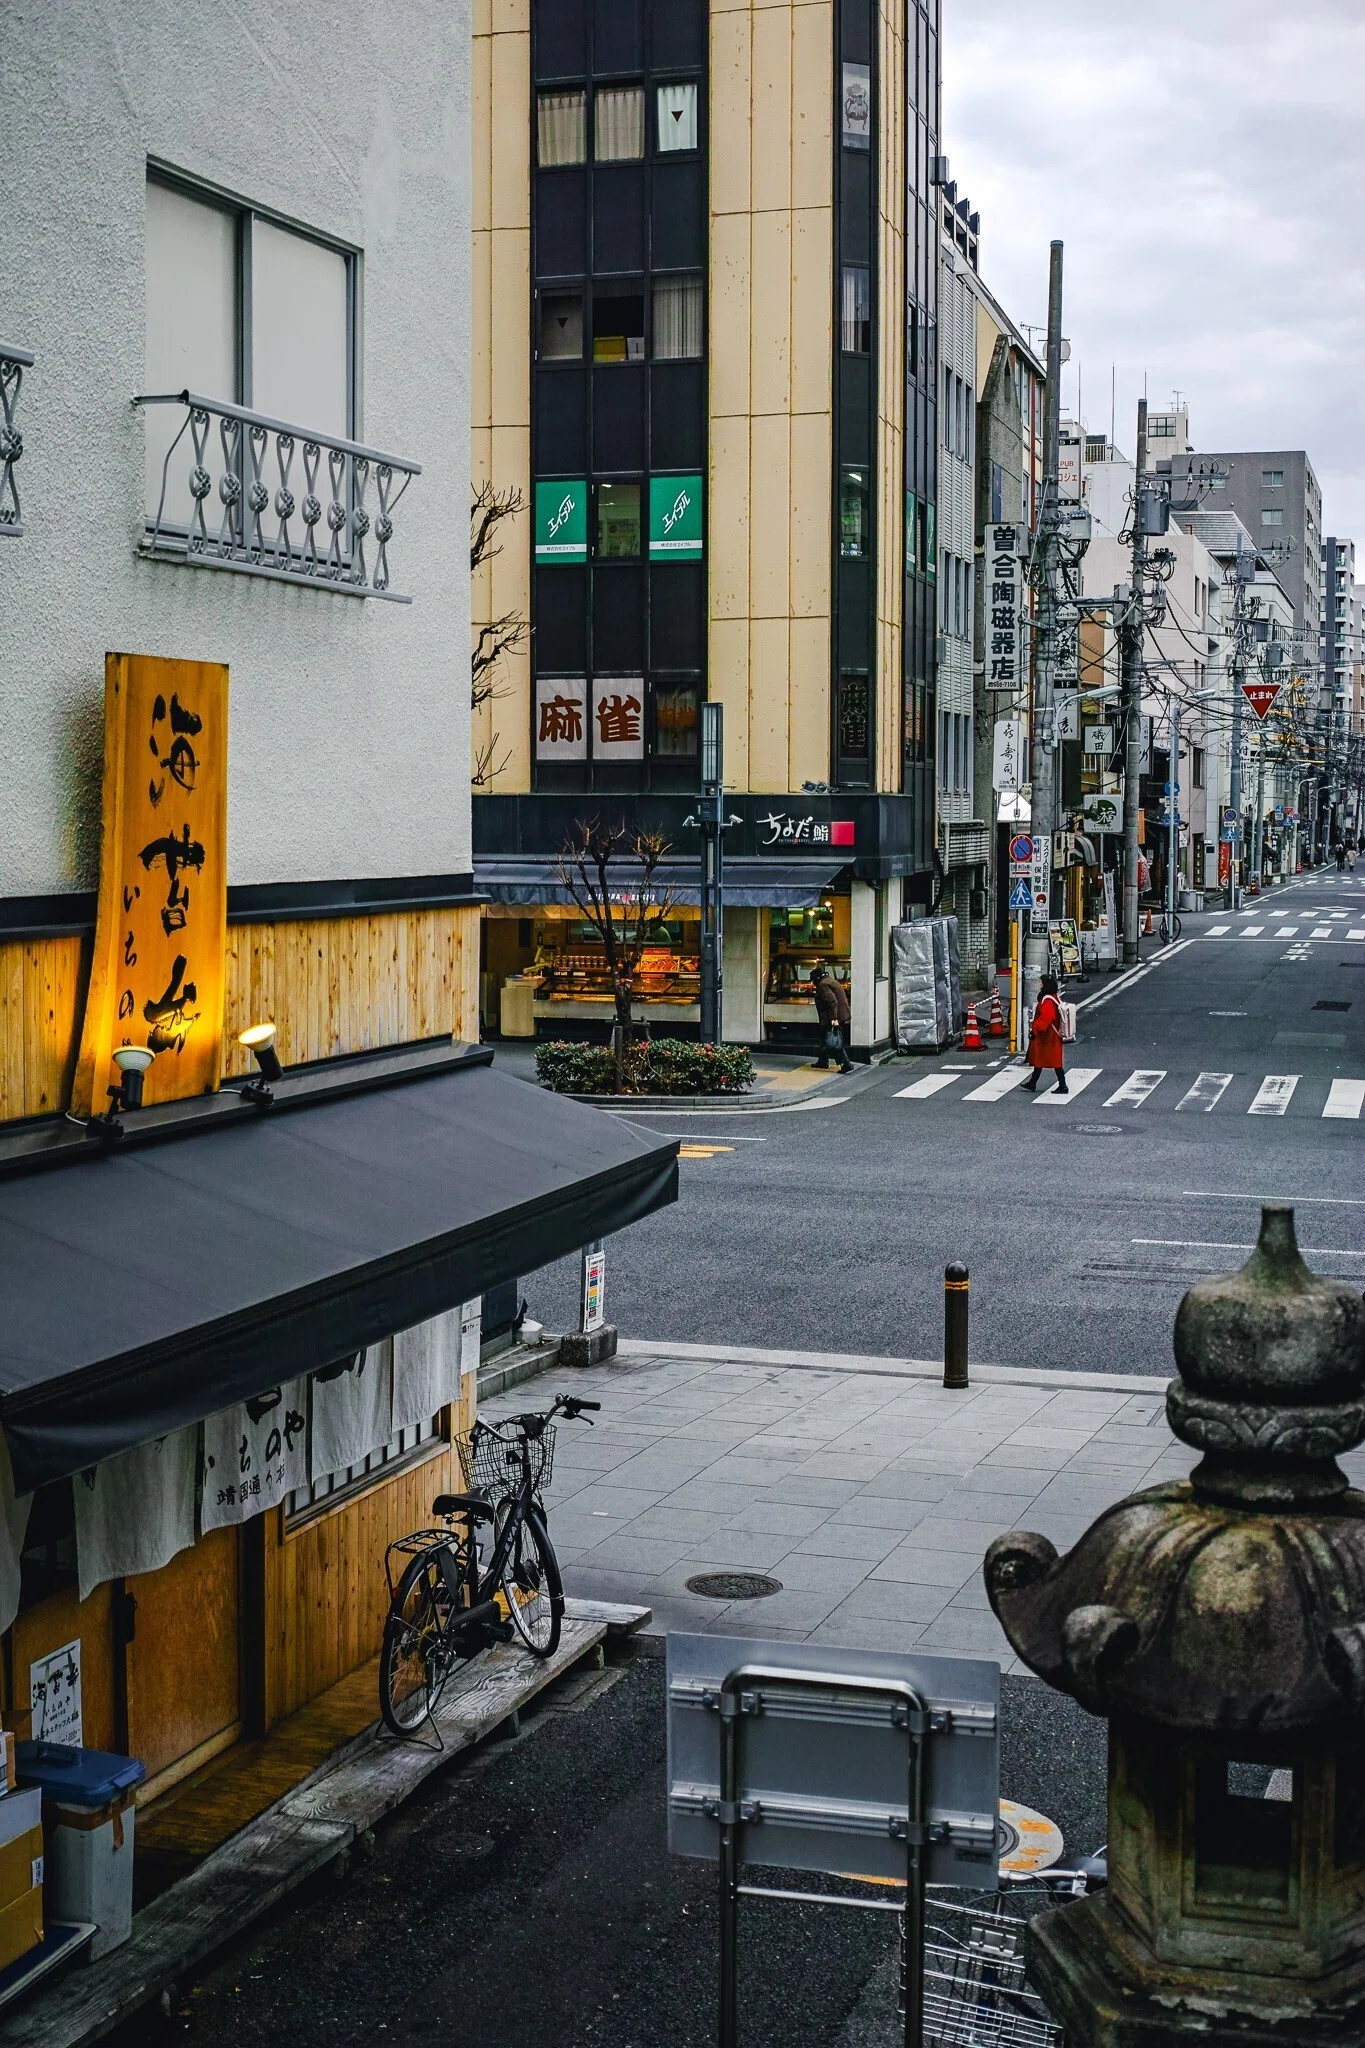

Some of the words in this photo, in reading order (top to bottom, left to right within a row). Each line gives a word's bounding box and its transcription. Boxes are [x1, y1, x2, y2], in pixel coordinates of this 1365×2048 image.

[547, 494, 575, 538] エイブル
[661, 489, 691, 534] エイブル
[1249, 691, 1273, 699] 止まれ
[538, 695, 642, 744] 麻雀
[757, 812, 829, 845] ちよだ鮨
[118, 881, 141, 1046] いちの
